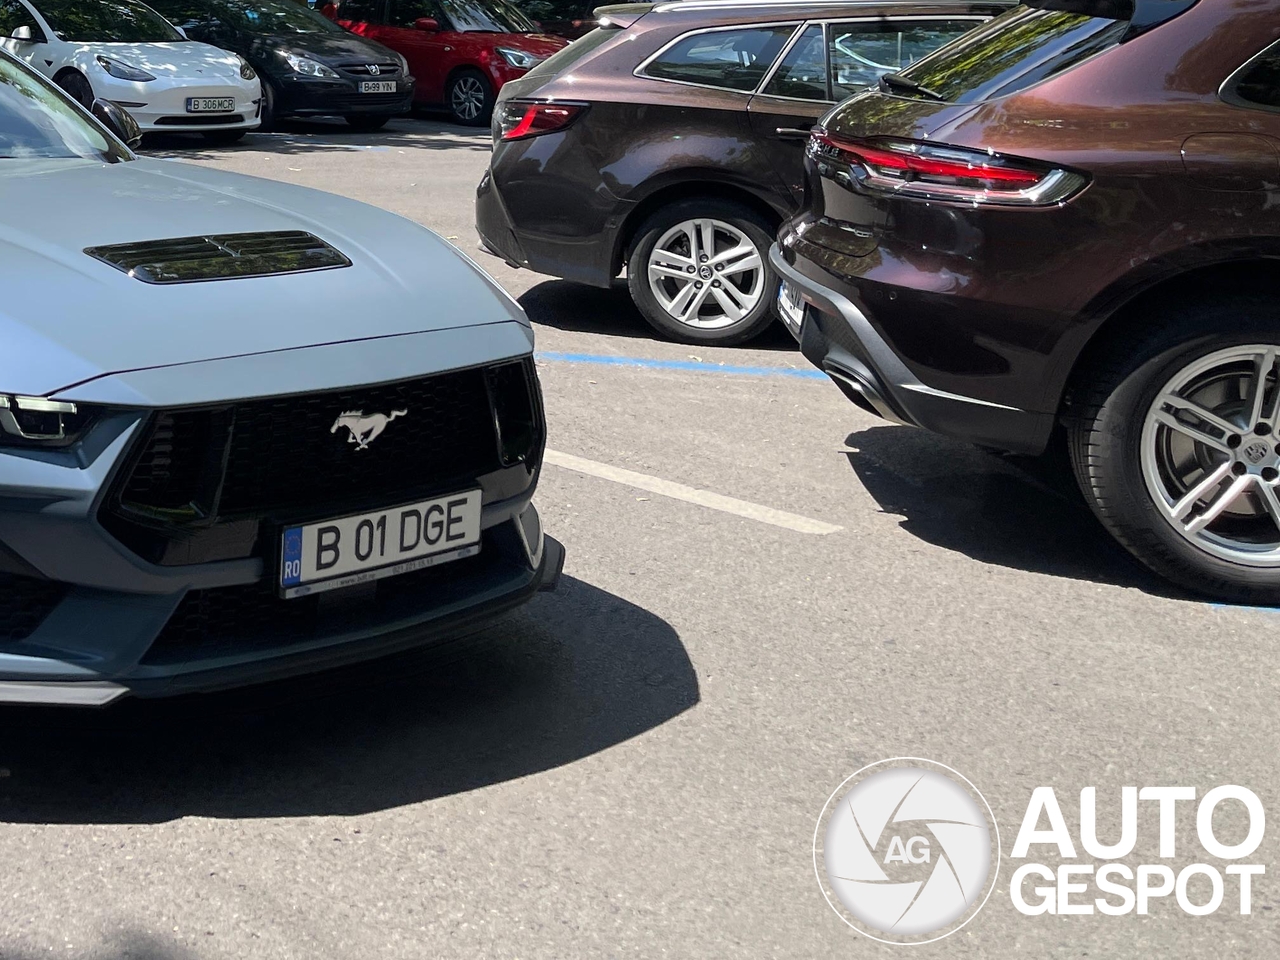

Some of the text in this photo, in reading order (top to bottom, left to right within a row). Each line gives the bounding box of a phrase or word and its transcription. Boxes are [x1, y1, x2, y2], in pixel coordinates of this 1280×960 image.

[363, 82, 370, 91] B
[193, 100, 200, 110] B
[315, 497, 468, 572] B 01 DGE
[284, 559, 300, 580] RO
